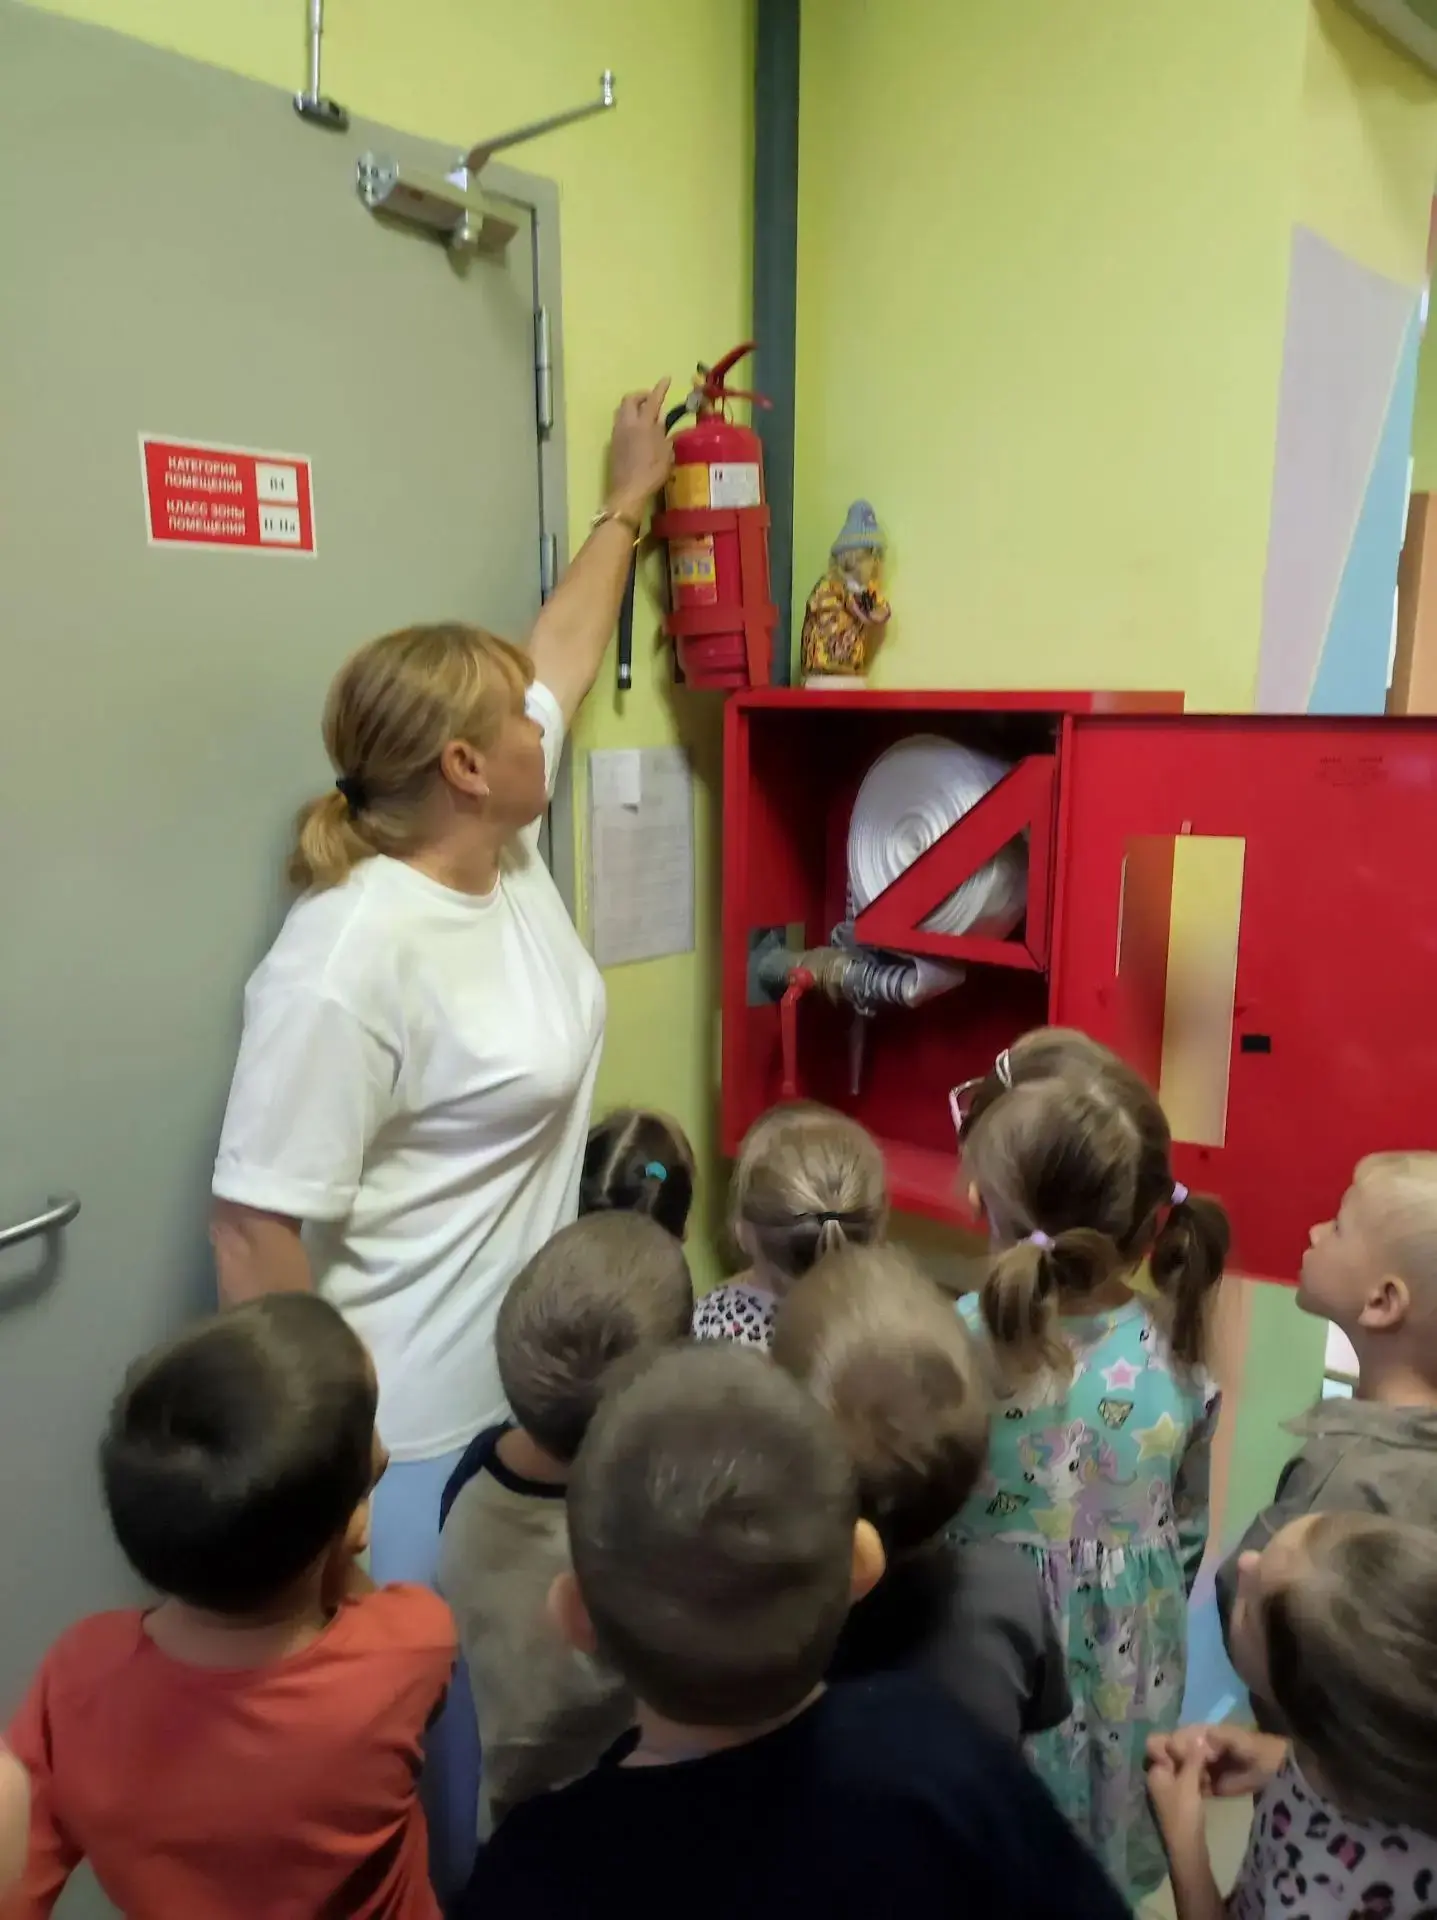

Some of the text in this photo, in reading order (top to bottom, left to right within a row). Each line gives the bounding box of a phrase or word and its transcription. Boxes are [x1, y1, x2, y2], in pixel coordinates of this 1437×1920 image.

[169, 455, 236, 477] КАТЕГОРИЯ
[165, 471, 243, 495] ПОМЕЩЕНИЯ
[166, 497, 245, 519] КЛАСС ЗОНЫ
[168, 515, 246, 537] ПОМЕЩЕНИЯ
